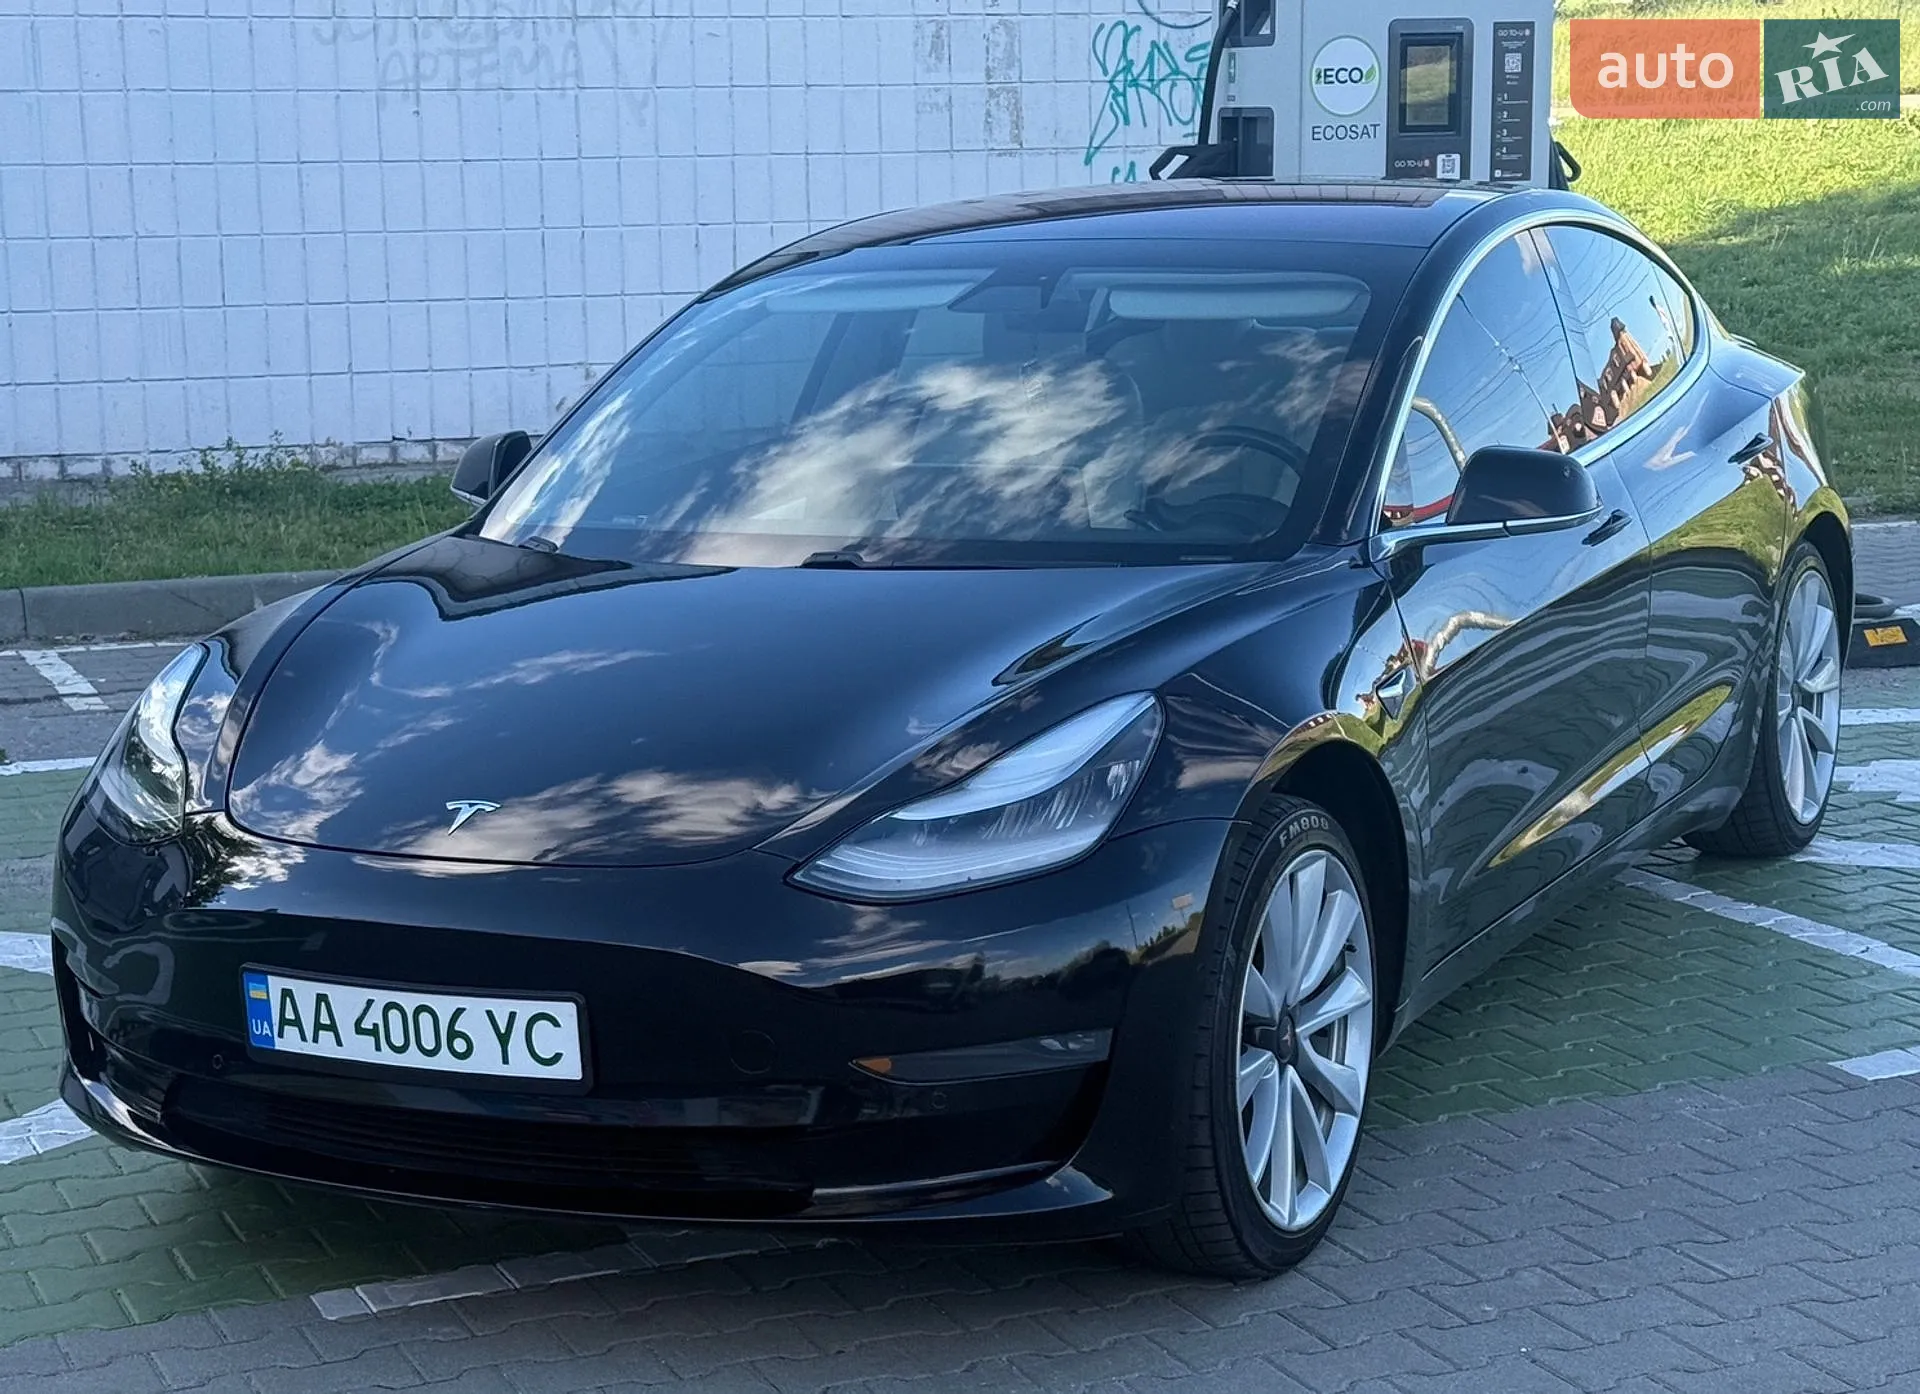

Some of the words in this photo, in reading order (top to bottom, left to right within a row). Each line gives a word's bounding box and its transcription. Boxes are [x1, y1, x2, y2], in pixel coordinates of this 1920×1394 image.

[1323, 66, 1364, 85] ECO
[1311, 123, 1381, 141] ECOSAT
[251, 1018, 272, 1037] UA
[277, 987, 344, 1048] AA
[354, 998, 475, 1061] 4006
[484, 1009, 565, 1067] YC
